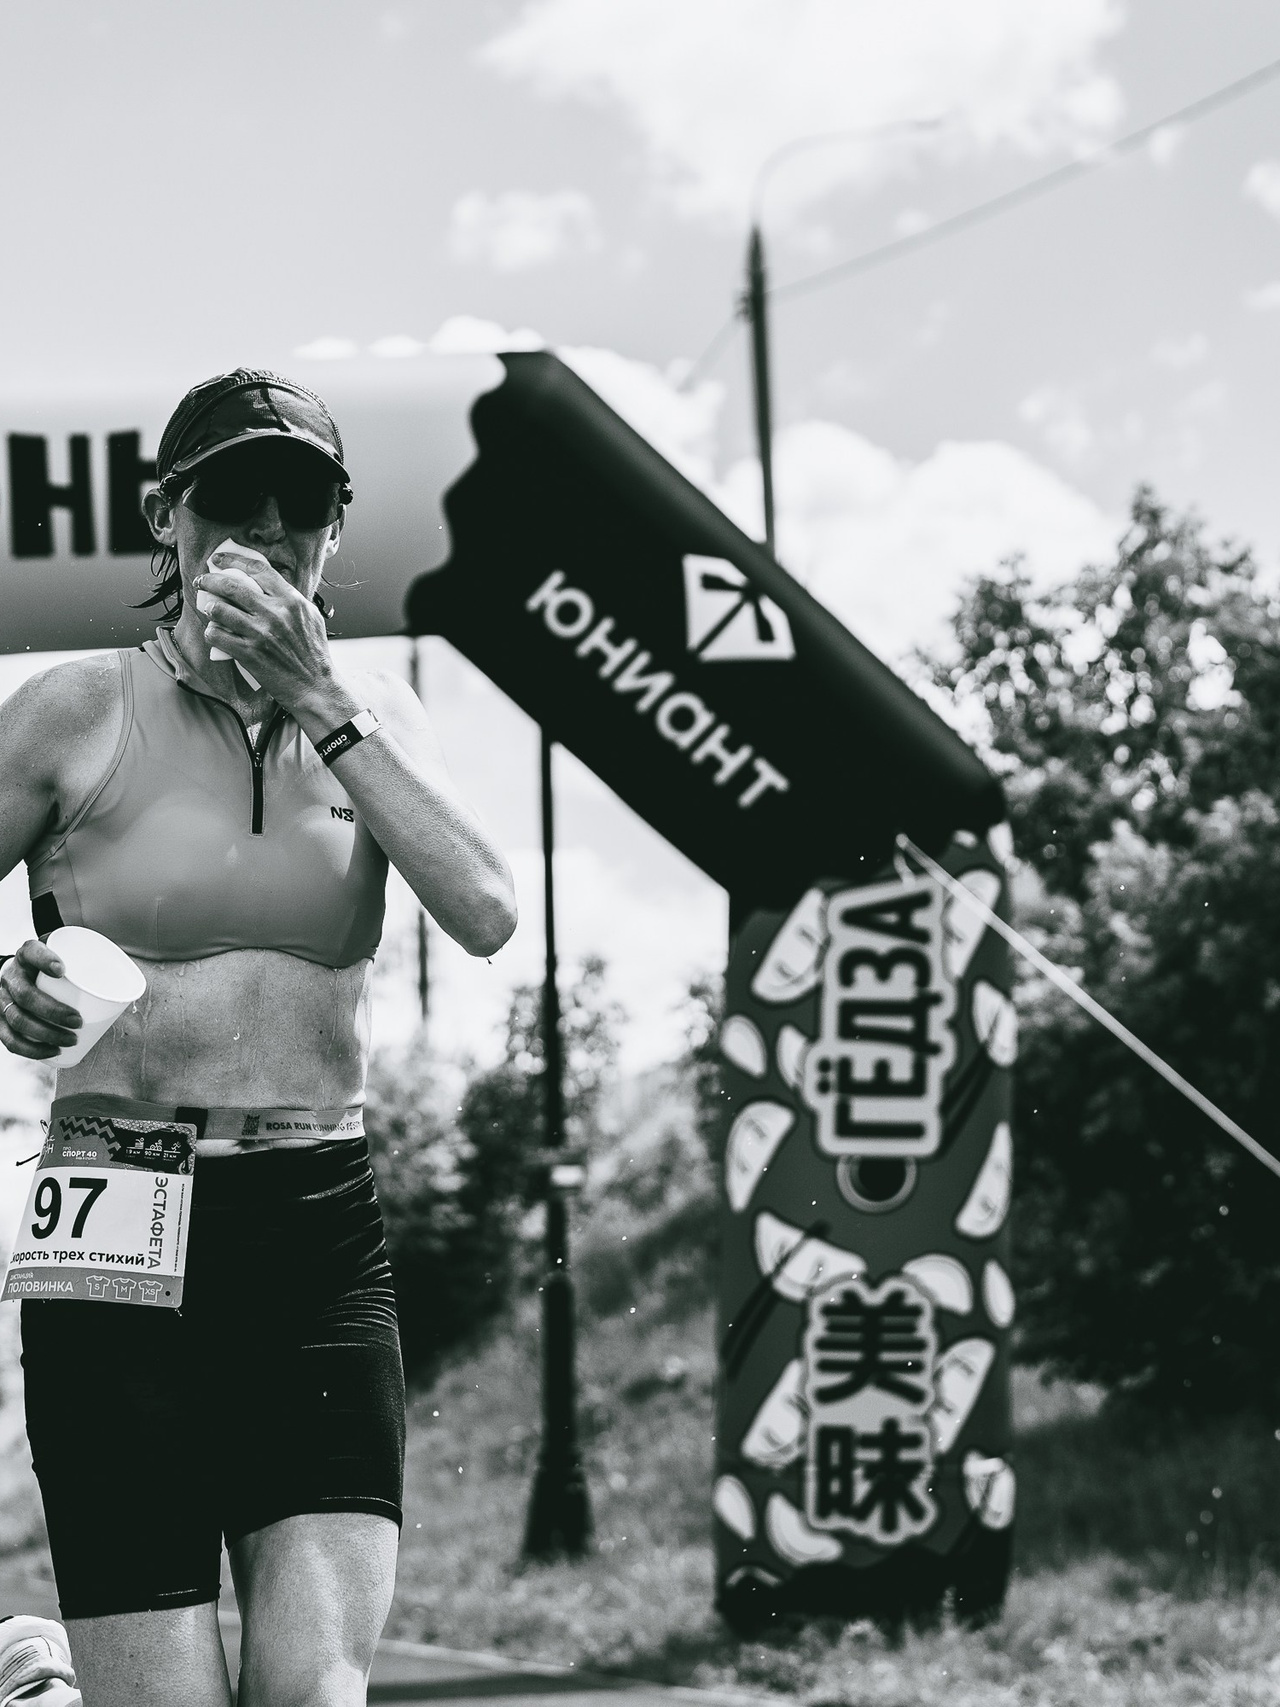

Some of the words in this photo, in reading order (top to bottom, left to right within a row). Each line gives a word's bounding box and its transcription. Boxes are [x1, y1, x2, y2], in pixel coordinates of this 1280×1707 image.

[322, 734, 347, 756] СПОРТ
[818, 890, 942, 1138] ГЁДЗА
[266, 1122, 292, 1131] ROSA
[294, 1122, 312, 1131] RUN
[86, 1150, 97, 1158] 40
[31, 1176, 108, 1240] 97
[147, 1176, 169, 1269] ЭСТАФЕТА
[10, 1251, 49, 1264] орость
[53, 1250, 85, 1263] трех
[89, 1251, 145, 1266] стихий
[8, 1281, 74, 1293] ПОЛОВИНКА
